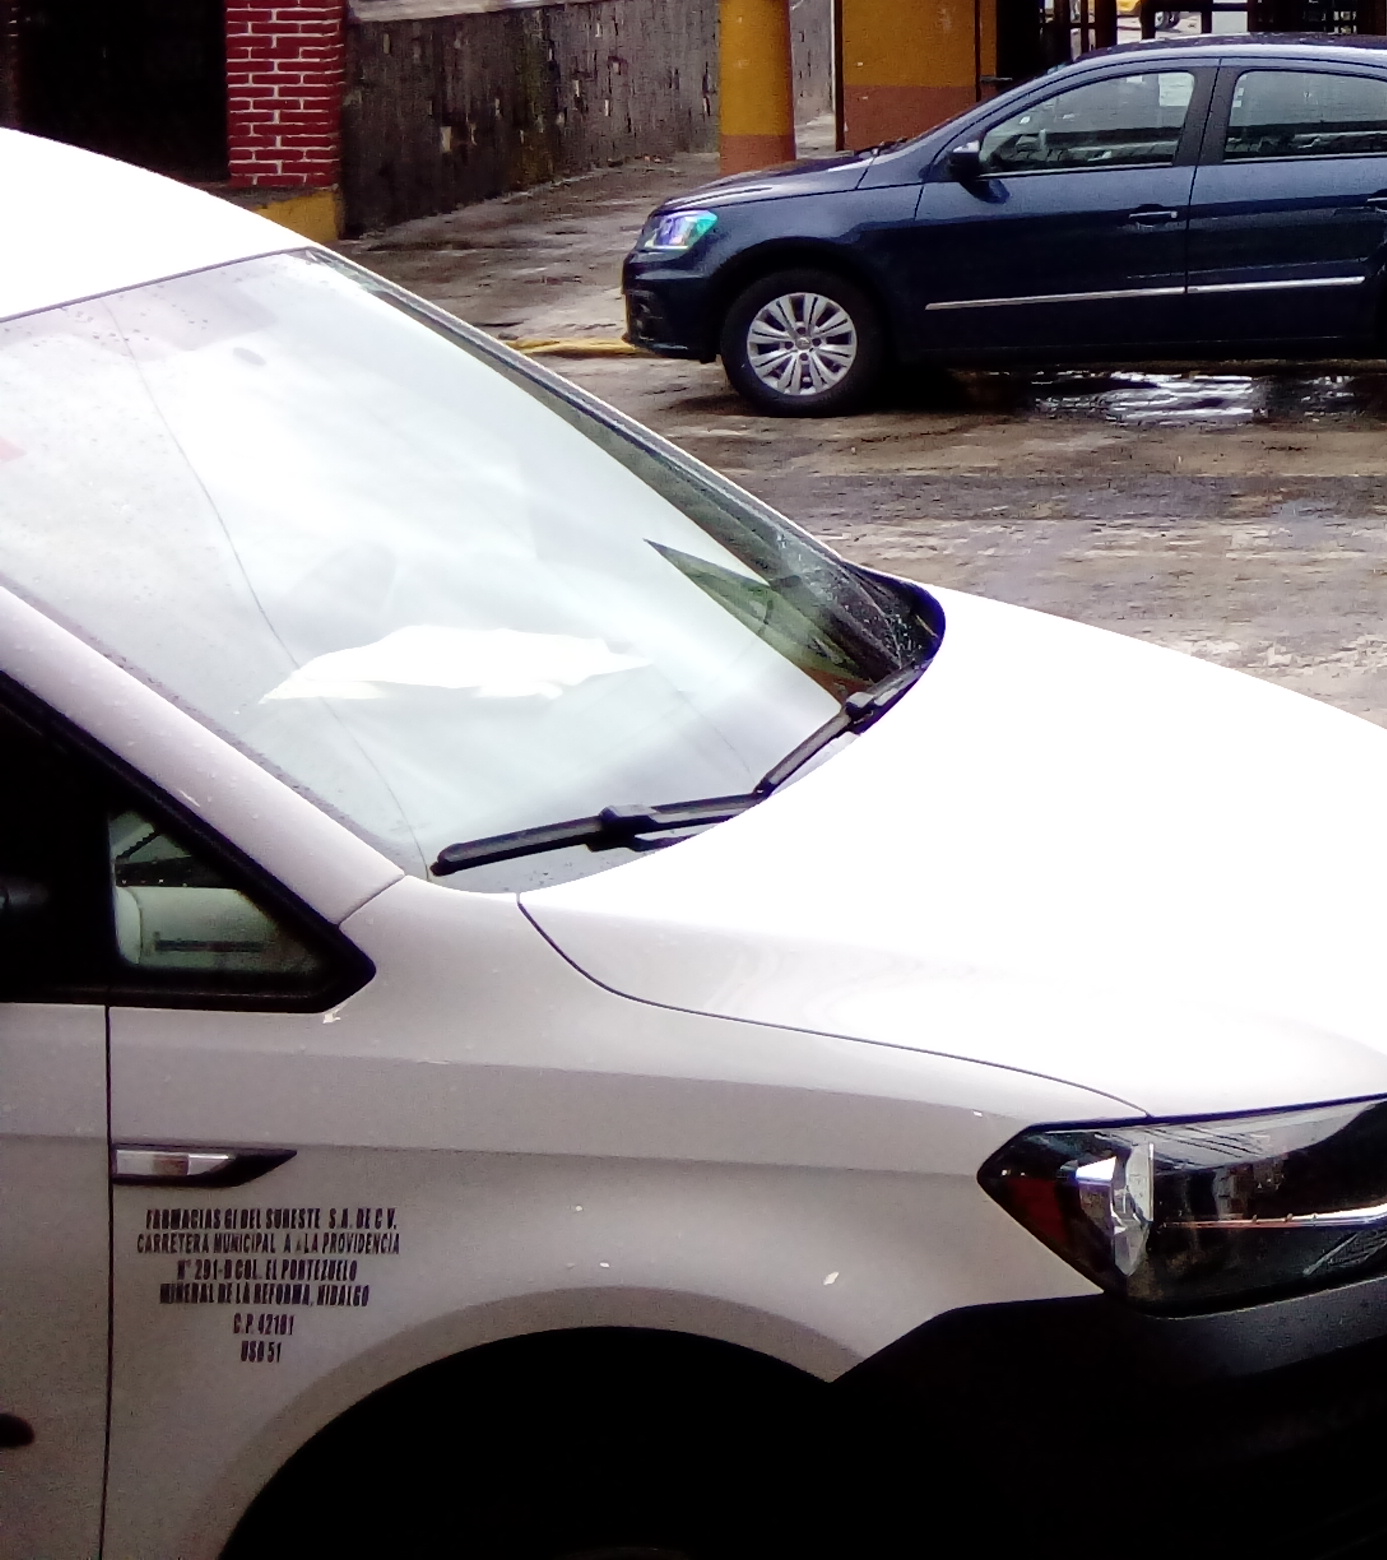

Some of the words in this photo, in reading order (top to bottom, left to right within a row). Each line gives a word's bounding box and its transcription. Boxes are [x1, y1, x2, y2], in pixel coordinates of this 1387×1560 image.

[146, 1208, 221, 1229] FARMACIAS
[240, 1208, 261, 1229] DEL
[265, 1208, 320, 1229] SURESTE
[356, 1208, 371, 1229] DE
[137, 1233, 210, 1254] CARRETERA
[213, 1233, 276, 1254] MUNICIPAL
[303, 1233, 319, 1254] LA
[322, 1233, 400, 1255] PROVIDENCIA
[265, 1258, 278, 1281] EL
[281, 1259, 358, 1282] PORTEZUELO
[235, 1281, 251, 1304] LA
[316, 1284, 370, 1307] HIDALGO
[267, 1341, 282, 1363] 51
